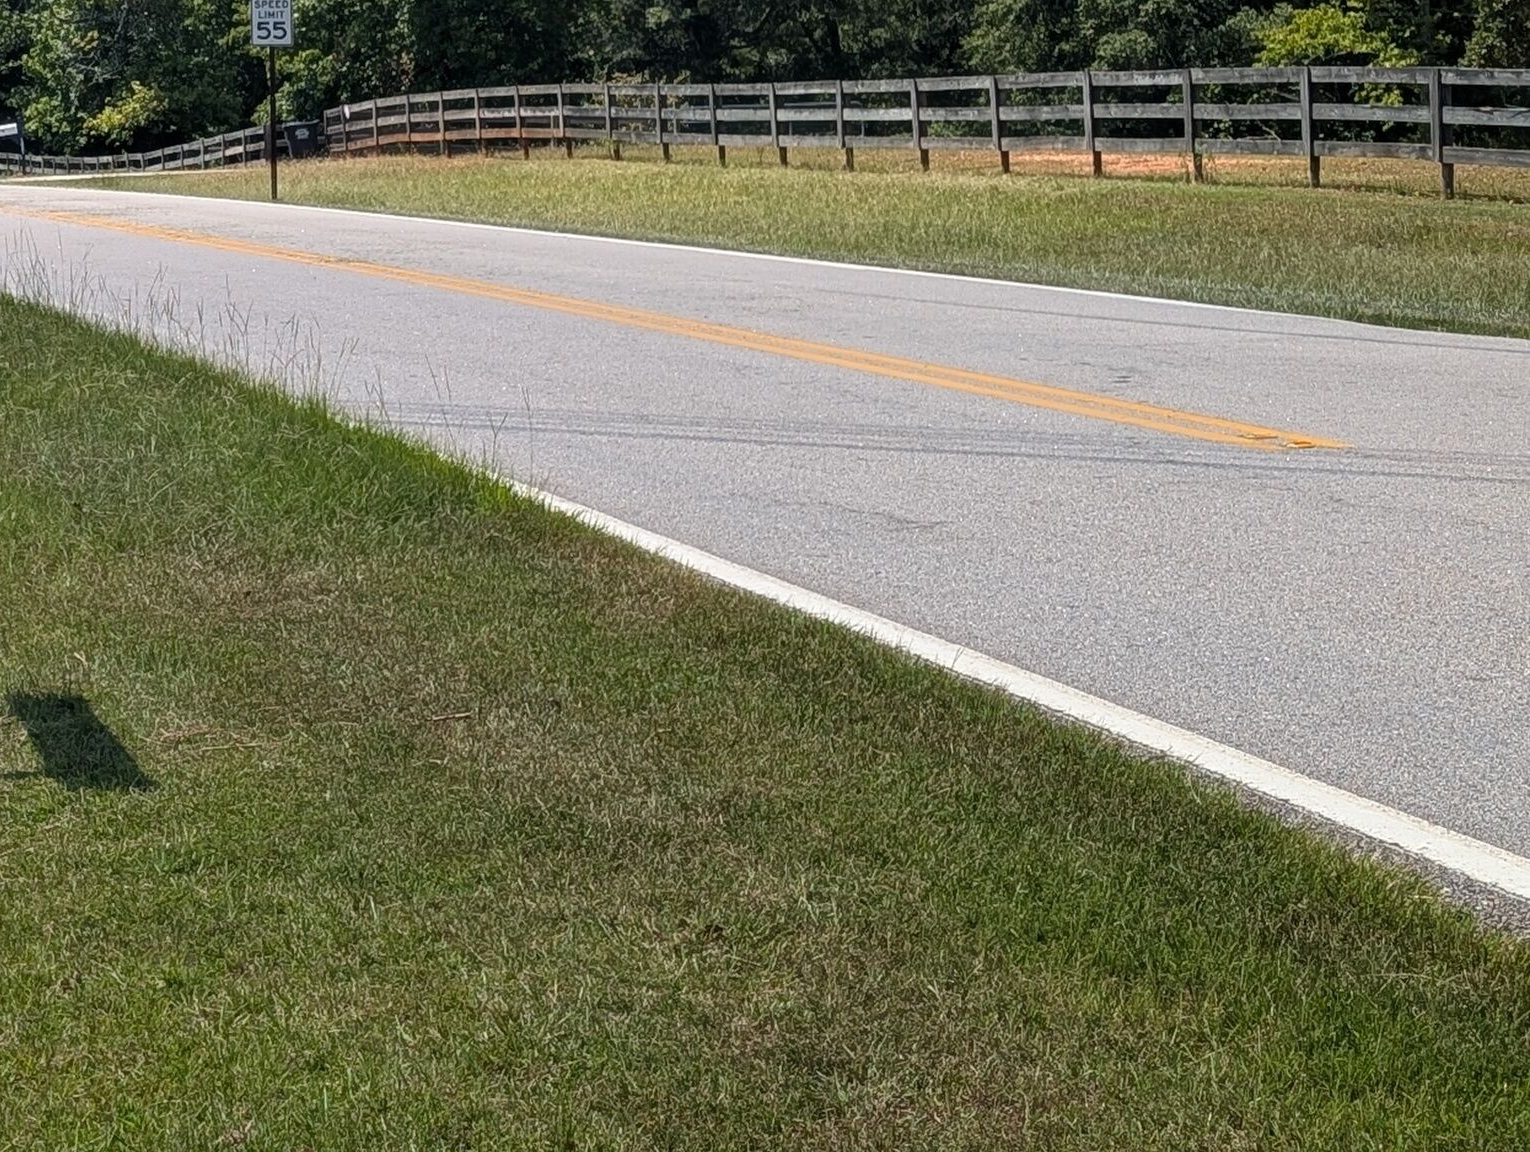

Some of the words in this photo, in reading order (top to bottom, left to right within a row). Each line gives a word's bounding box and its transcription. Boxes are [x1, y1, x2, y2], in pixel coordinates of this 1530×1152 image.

[254, 0, 289, 9] SPEED
[258, 10, 285, 19] LIMIT
[257, 21, 287, 40] 55
